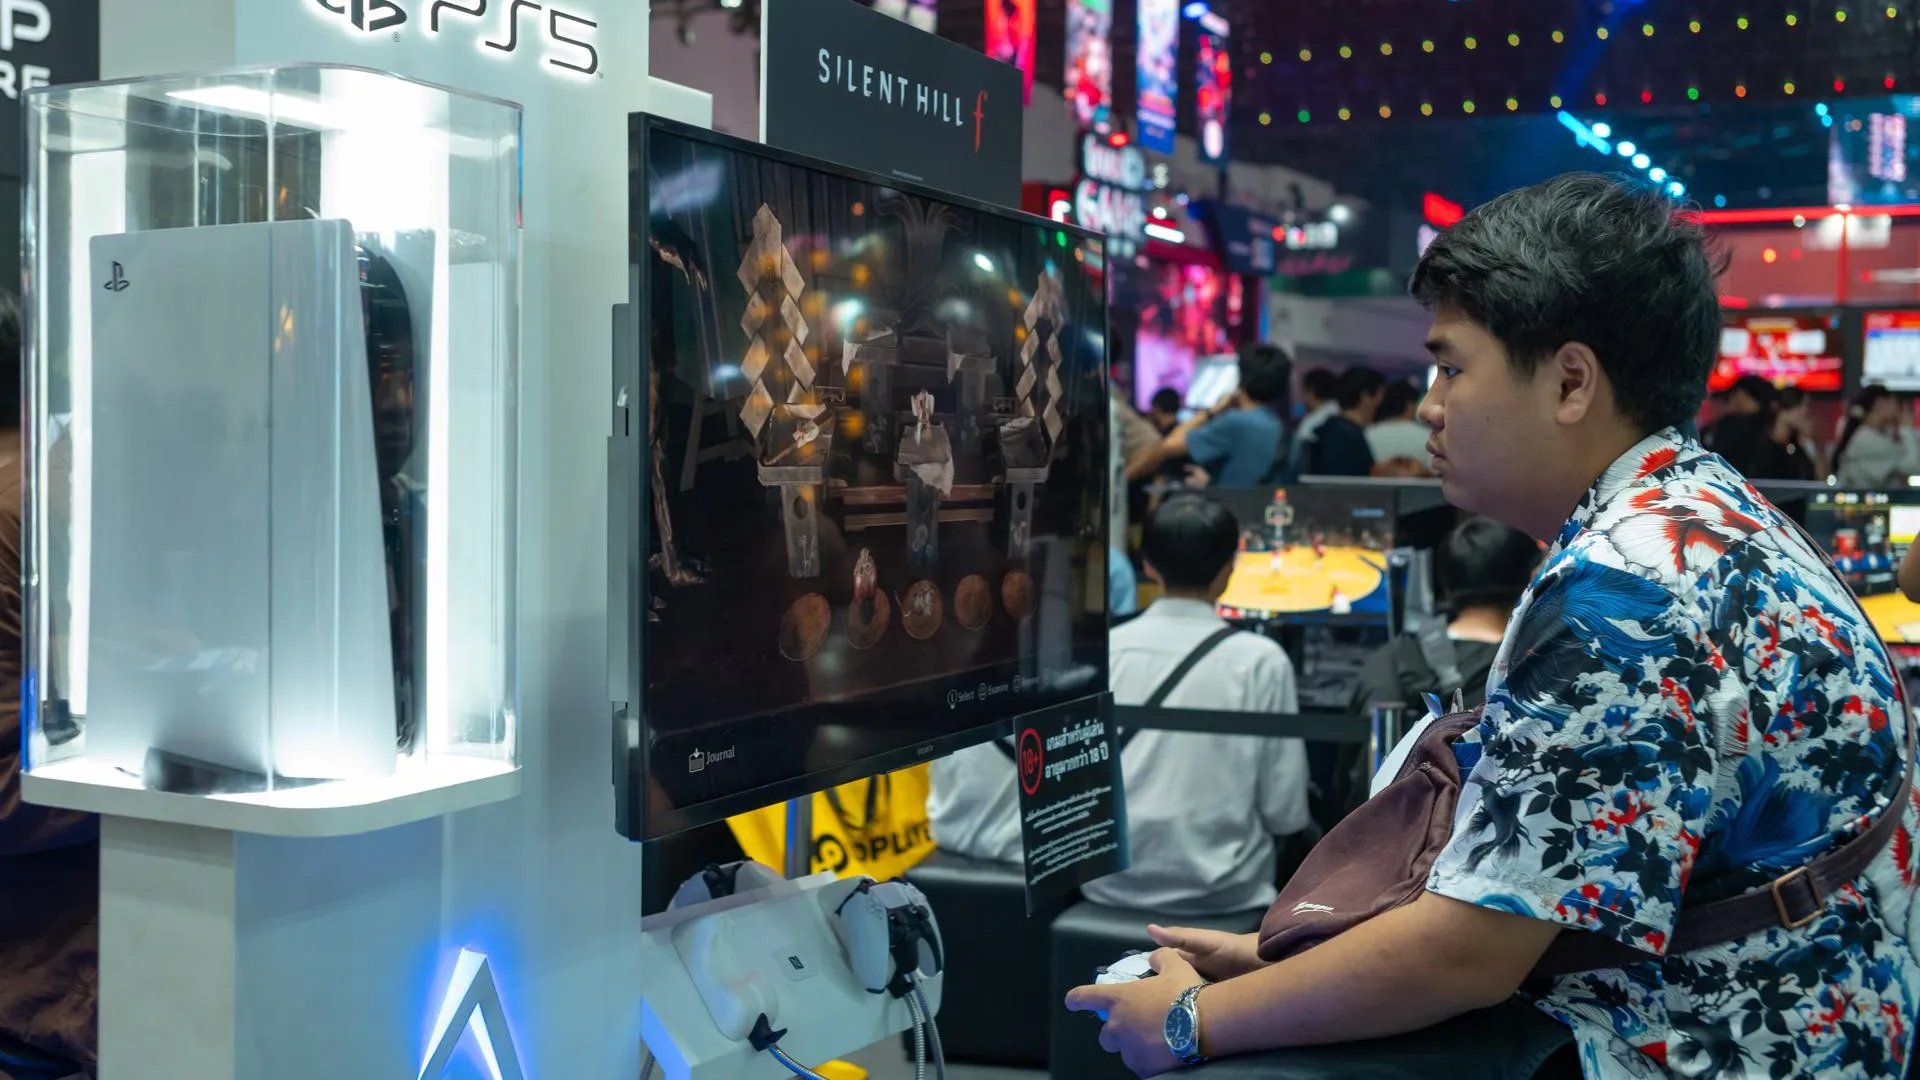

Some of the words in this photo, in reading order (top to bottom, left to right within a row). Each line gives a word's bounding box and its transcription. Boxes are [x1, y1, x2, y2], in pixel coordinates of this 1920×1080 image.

[430, 0, 598, 75] PS5
[818, 47, 909, 107] SILENT
[916, 83, 963, 127] HILL
[972, 90, 988, 154] f
[958, 689, 975, 703] Select
[706, 744, 735, 765] Journal
[1023, 748, 1039, 777] 18+
[1089, 747, 1100, 764] 18
[1100, 740, 1109, 761] ปี
